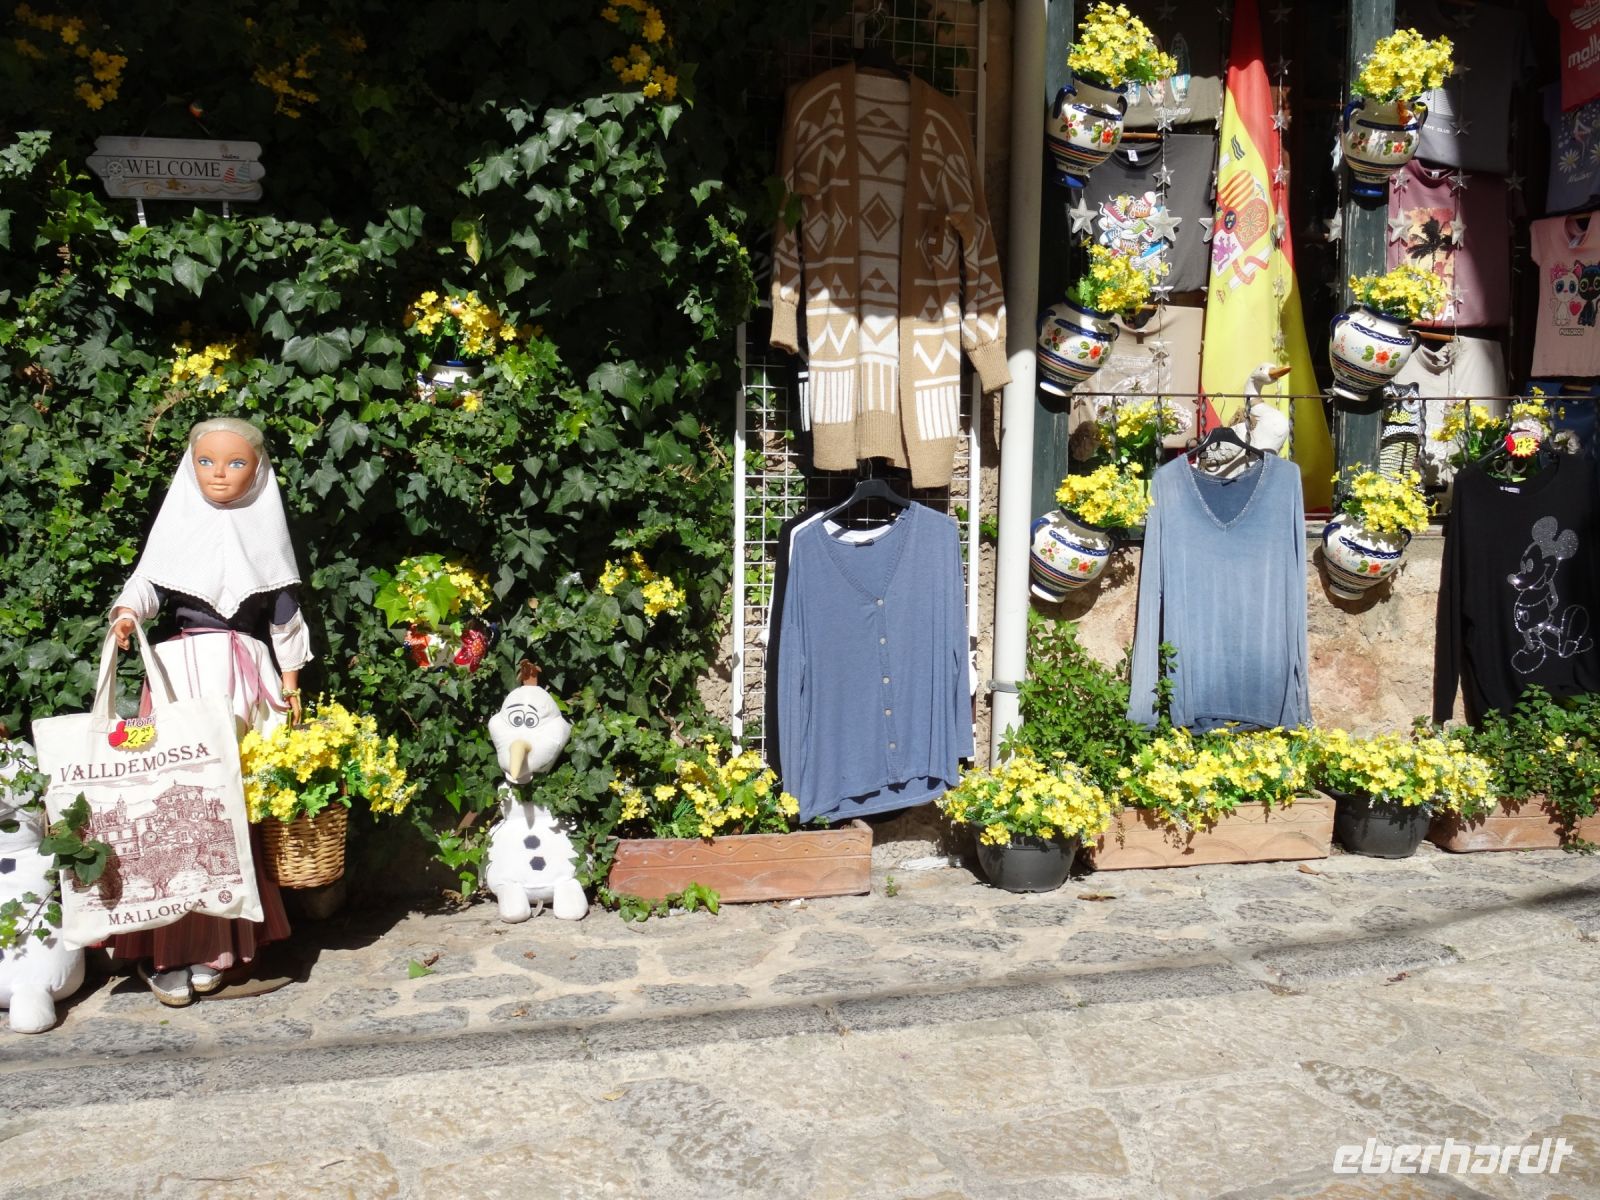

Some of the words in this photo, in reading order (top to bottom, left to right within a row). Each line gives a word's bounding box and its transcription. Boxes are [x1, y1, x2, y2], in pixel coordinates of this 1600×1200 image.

[126, 159, 221, 178] WELCOME
[60, 742, 211, 782] VALLDEMOSSA
[108, 898, 209, 926] MALLORCA
